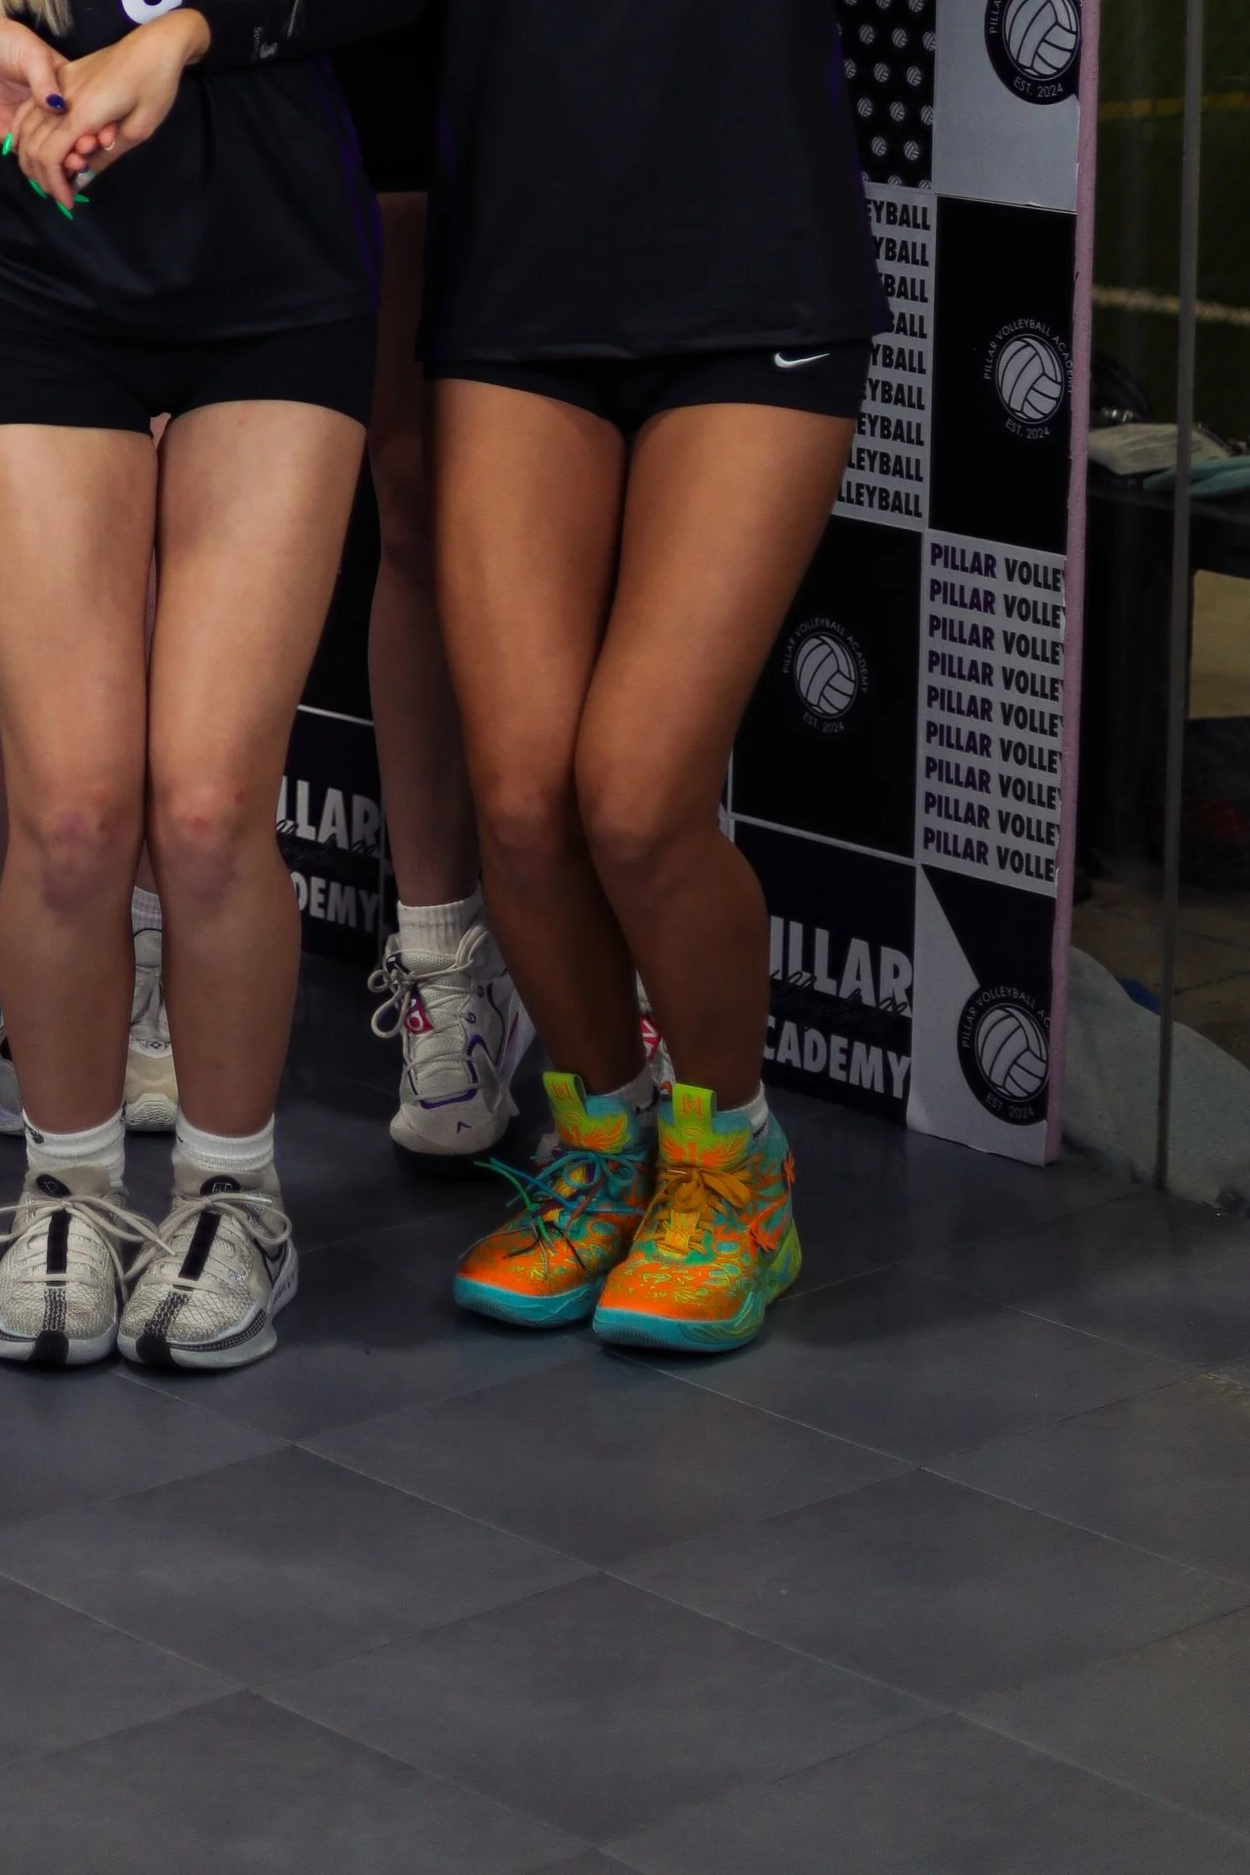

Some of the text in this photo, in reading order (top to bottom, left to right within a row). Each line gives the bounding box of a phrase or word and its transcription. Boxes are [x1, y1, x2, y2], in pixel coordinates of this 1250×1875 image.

[984, 317, 1051, 380] PILLAR VOLLEYBALL
[930, 542, 996, 578] PILLAR
[930, 578, 995, 614] PILLAR
[929, 613, 994, 650] PILLAR
[928, 649, 993, 686] PILLAR
[927, 685, 992, 722] PILLAR
[926, 720, 992, 757] PILLAR
[925, 756, 991, 793] PILLAR
[924, 791, 990, 829] PILLAR
[924, 827, 989, 865] PILLAR
[769, 915, 913, 1018] ILLAR
